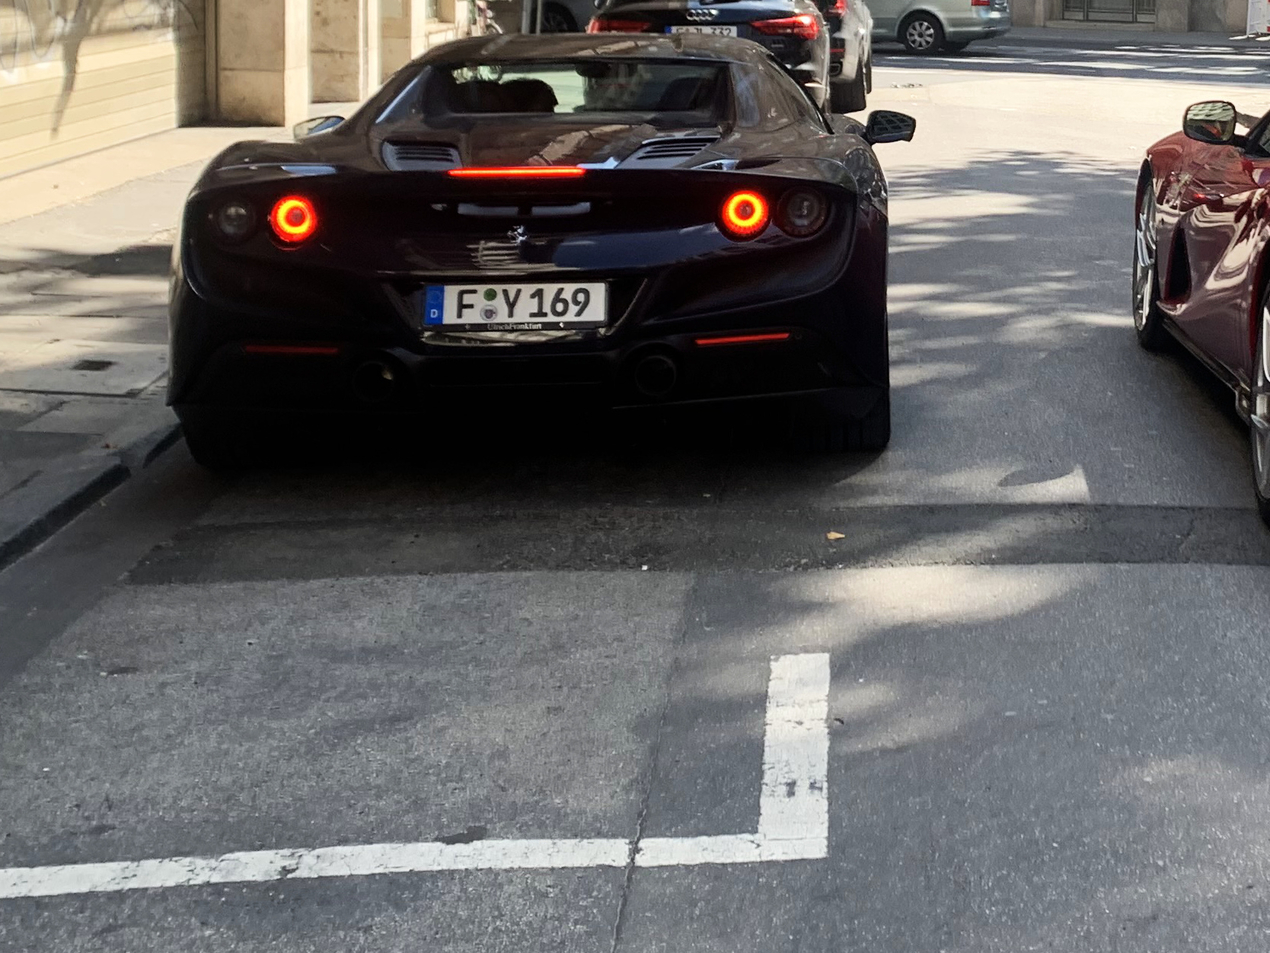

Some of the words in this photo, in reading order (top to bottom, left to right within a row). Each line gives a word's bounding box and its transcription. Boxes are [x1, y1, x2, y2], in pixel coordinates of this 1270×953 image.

[456, 289, 478, 319] F
[502, 288, 522, 318] Y
[529, 287, 590, 318] 169
[430, 309, 438, 318] D
